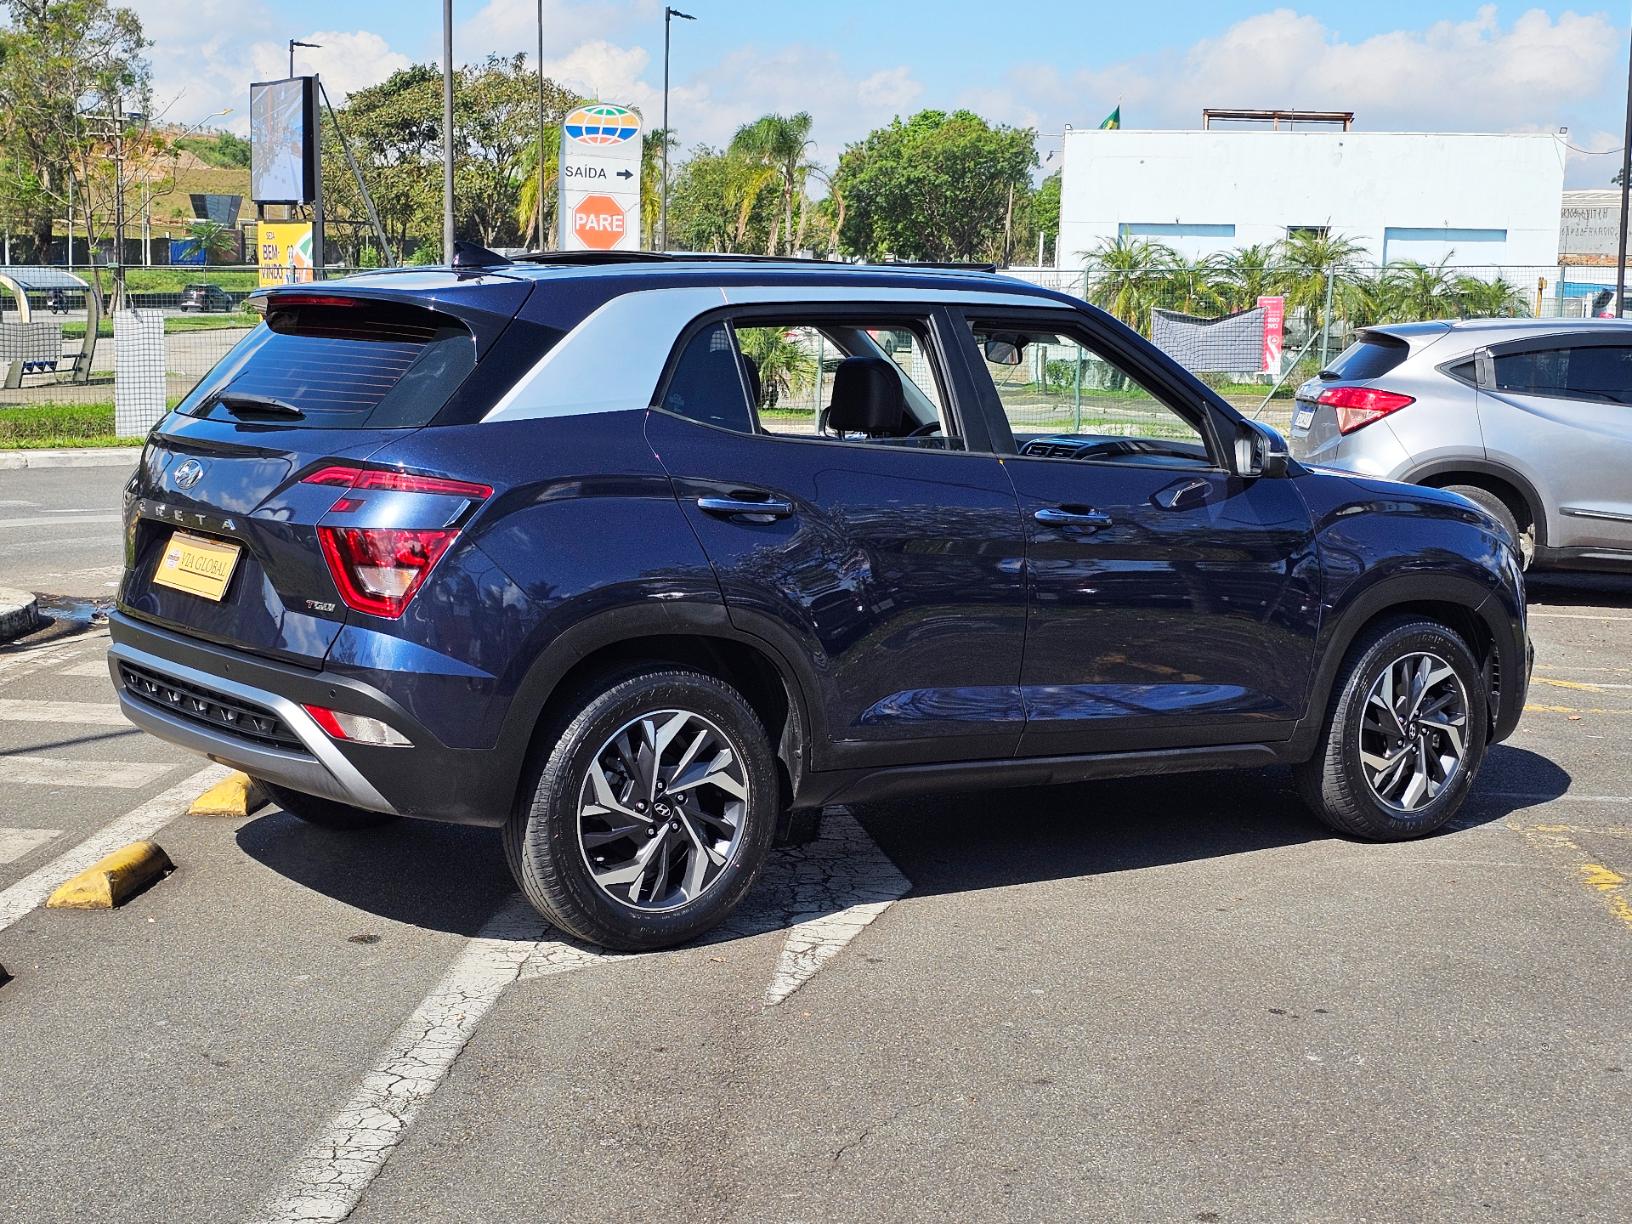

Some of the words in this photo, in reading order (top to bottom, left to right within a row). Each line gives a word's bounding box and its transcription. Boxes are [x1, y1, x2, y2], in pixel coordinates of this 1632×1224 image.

[565, 164, 607, 179] SAÍDA
[575, 213, 624, 232] PARE
[181, 552, 196, 568] VIA
[195, 556, 228, 577] GLOBAL
